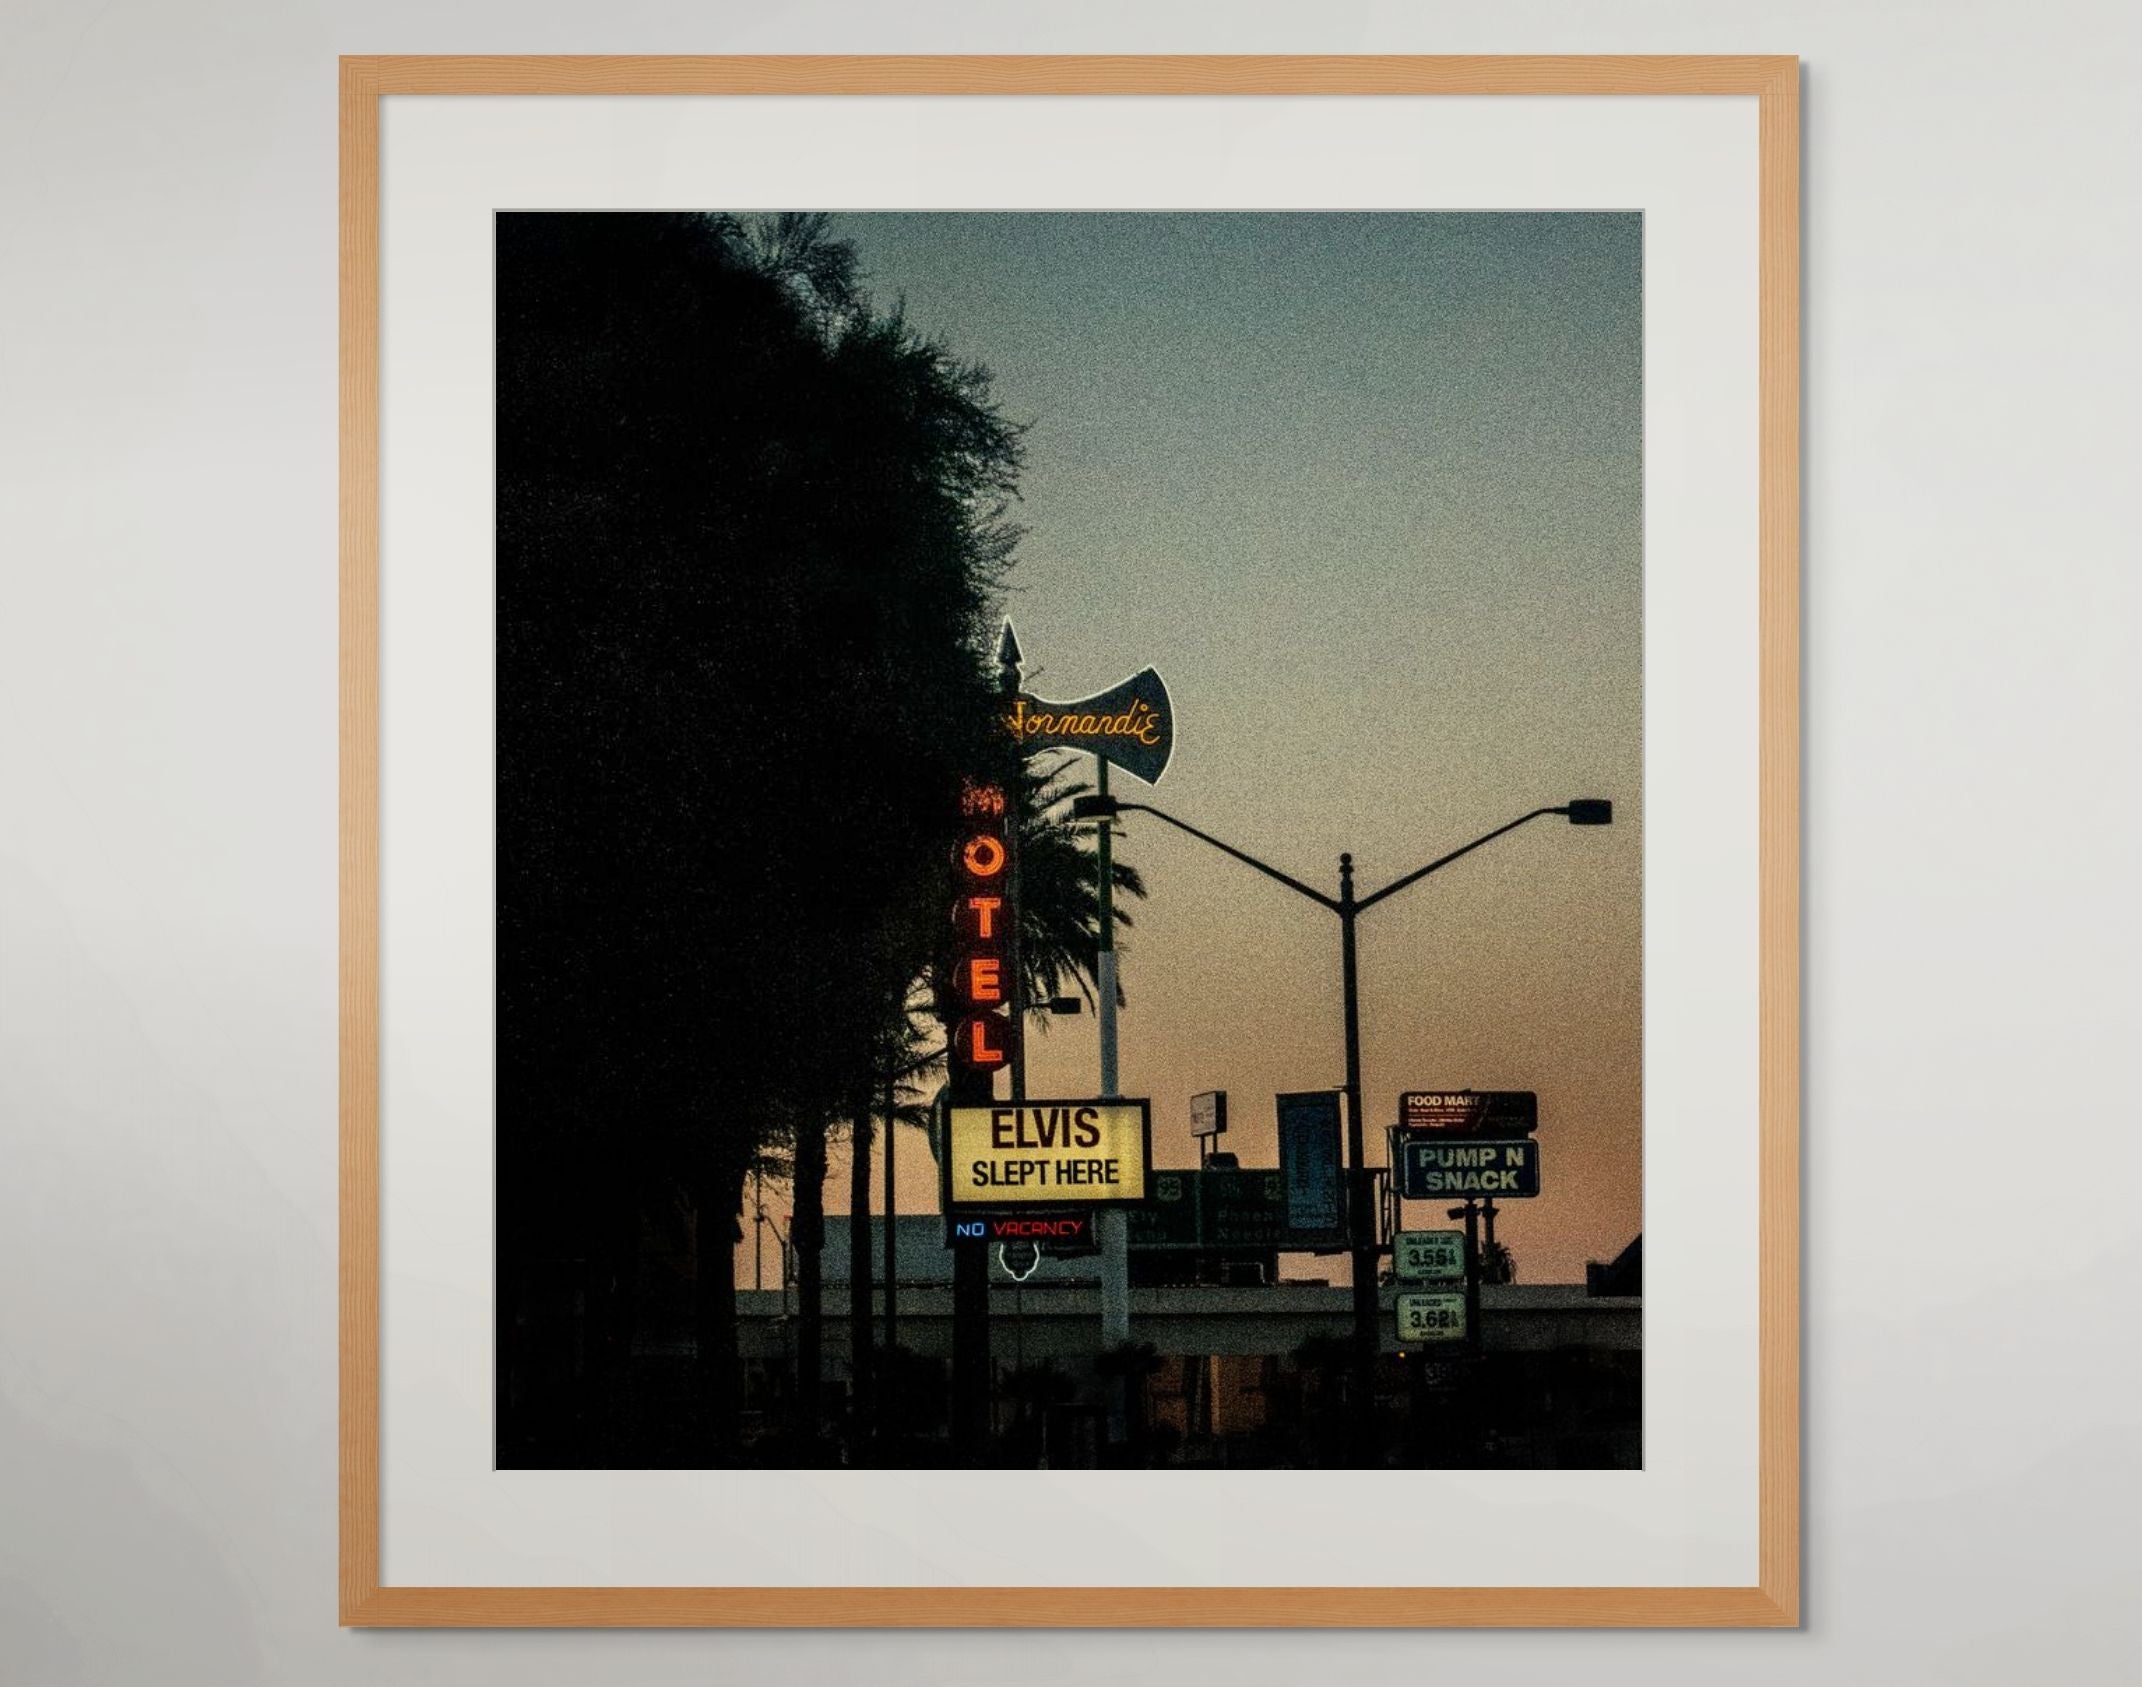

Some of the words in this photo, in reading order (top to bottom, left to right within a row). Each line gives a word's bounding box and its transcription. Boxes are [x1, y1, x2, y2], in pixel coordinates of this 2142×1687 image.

[961, 783, 1004, 1062] MOTEL
[1407, 1095, 1442, 1107] FOOD
[991, 1107, 1101, 1149] ELVIS
[1418, 1147, 1498, 1168] PUMP
[1506, 1147, 1525, 1167] N
[972, 1160, 1050, 1187] SLEPT
[1056, 1159, 1120, 1185] HERE
[1425, 1170, 1519, 1191] SNACK
[956, 1222, 985, 1237] NO
[992, 1220, 1083, 1237] VACANCY
